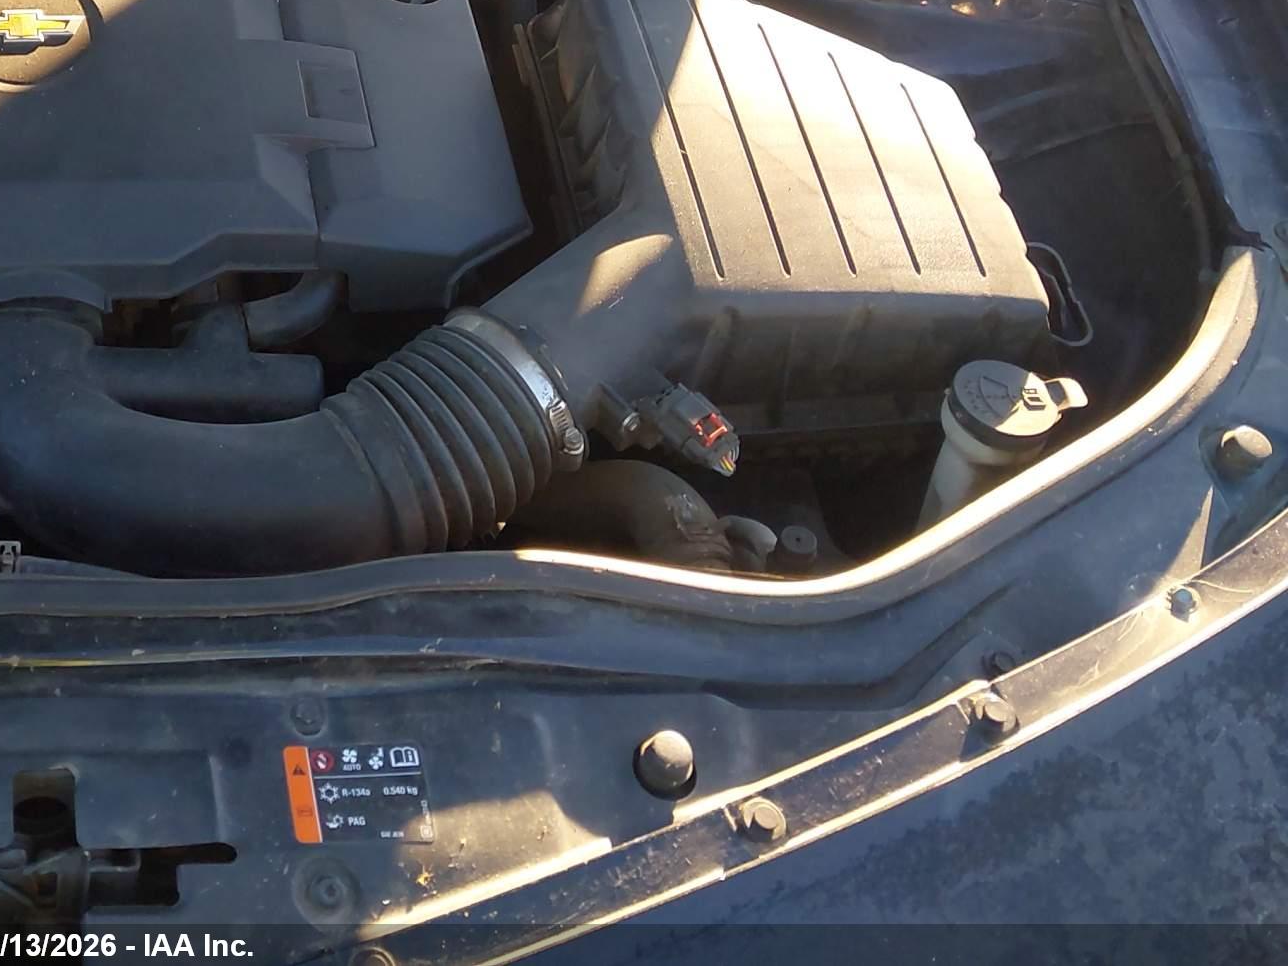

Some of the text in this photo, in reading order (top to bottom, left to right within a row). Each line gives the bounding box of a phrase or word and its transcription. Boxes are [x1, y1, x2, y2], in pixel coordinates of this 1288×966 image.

[343, 763, 361, 771] AUTO
[342, 785, 418, 796] R-134a 0.540 kg
[348, 816, 366, 827] PAG
